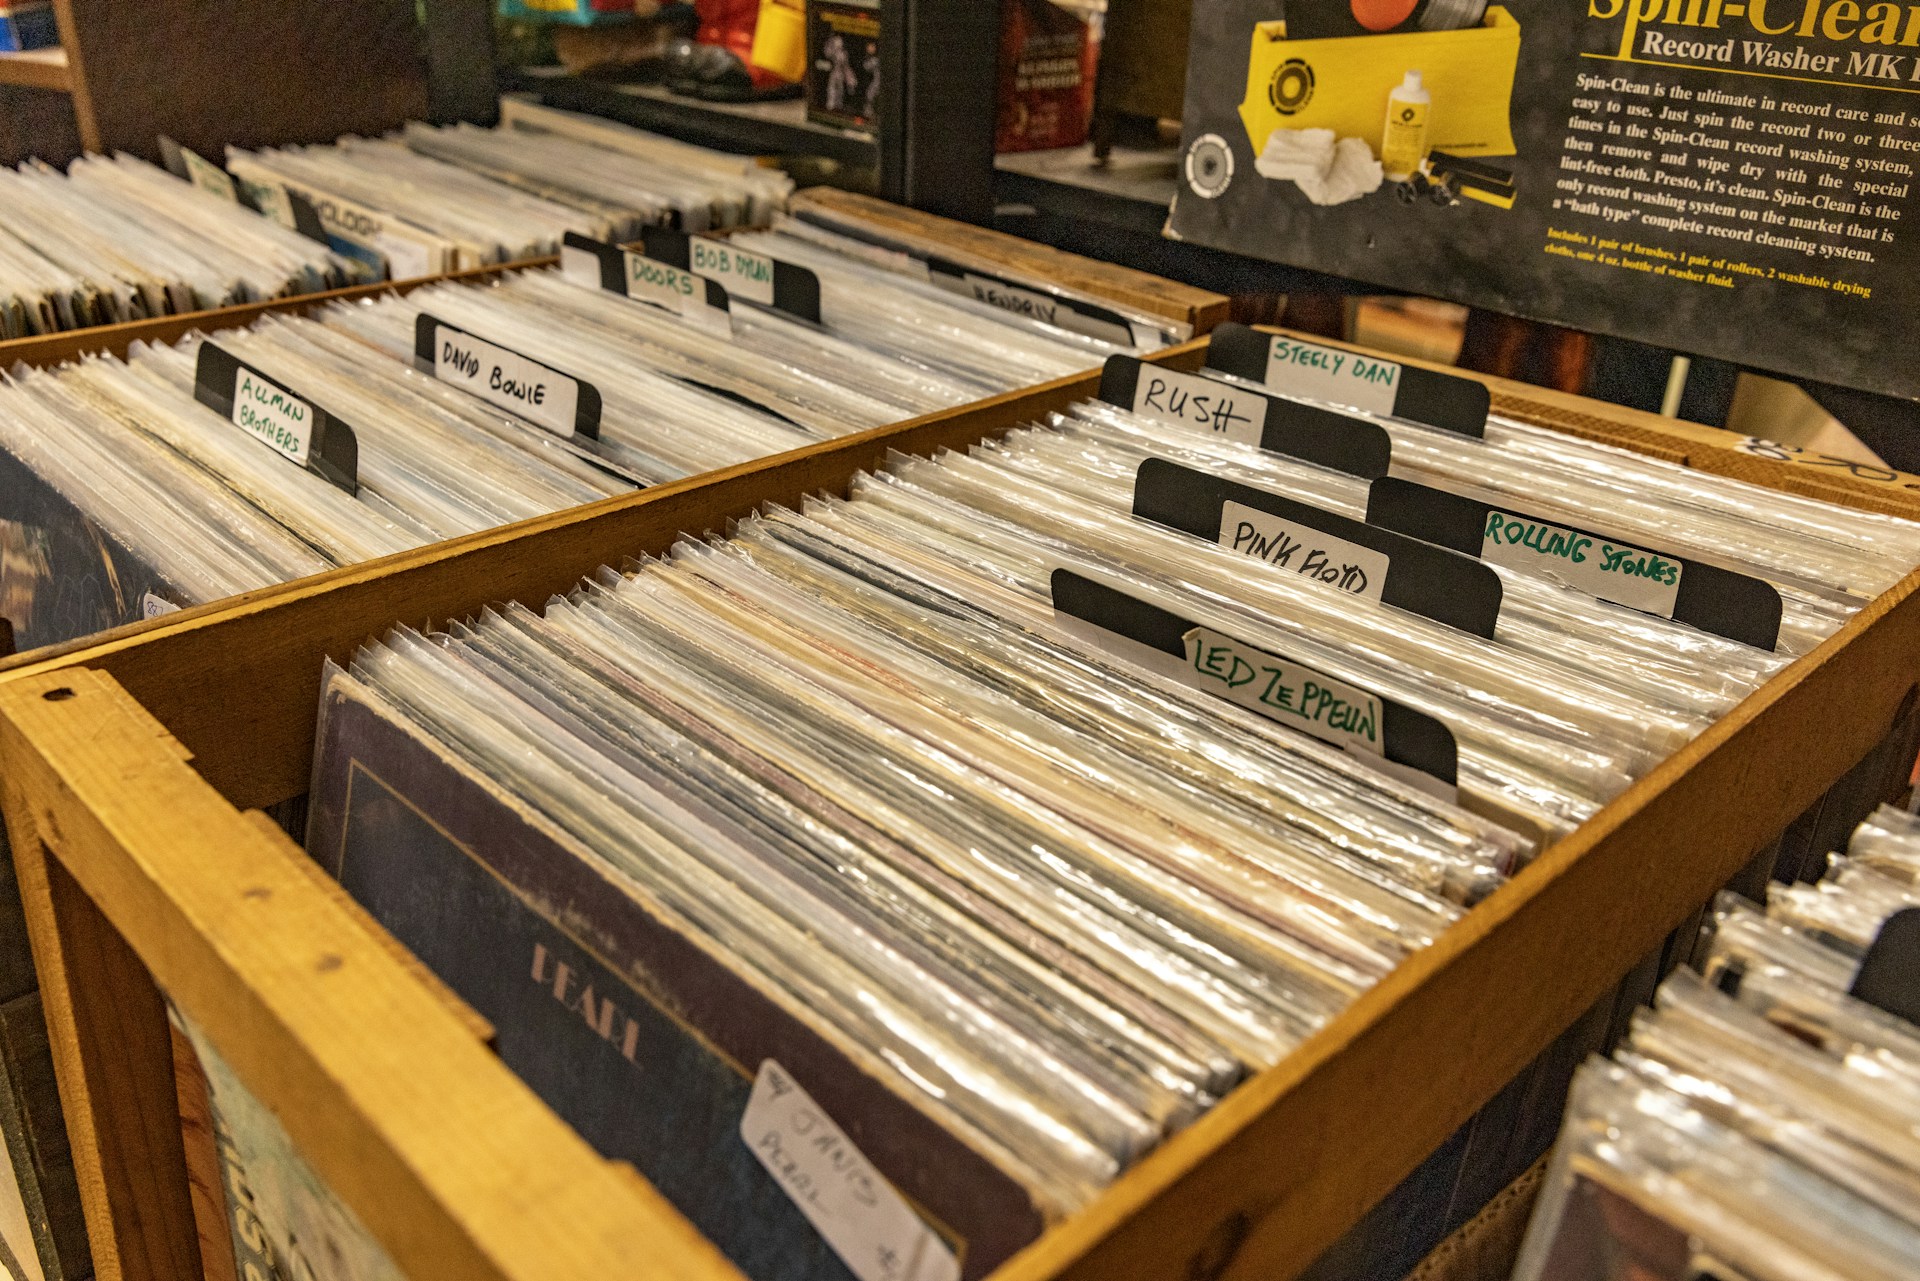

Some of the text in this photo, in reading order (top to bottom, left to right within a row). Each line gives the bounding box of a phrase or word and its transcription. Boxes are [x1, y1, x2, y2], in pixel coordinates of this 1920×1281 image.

[1641, 30, 1735, 62] Record
[1742, 40, 1839, 73] Washer
[1844, 51, 1906, 81] MK
[1572, 97, 1920, 152] easy to use. Just spin the record two or three
[1576, 73, 1650, 95] Spin-Clean
[1654, 82, 1666, 97] is
[1670, 85, 1693, 100] the
[1696, 89, 1757, 108] ultimate
[1760, 96, 1776, 110] in
[1781, 101, 1831, 117] record
[1835, 107, 1869, 122] care
[1874, 111, 1906, 128] and
[1564, 136, 1909, 198] then remove and wipe dry with the special
[1568, 116, 1914, 178] times in the Spin-Clean record washing system,
[1556, 178, 1895, 243] only record washing system on the market that is
[1560, 155, 1901, 221] lint-free cloth. Presto, it’s clean. Spin-Clean is the
[694, 244, 730, 272] BOB
[1552, 198, 1562, 209] a
[1641, 213, 1704, 233] complete
[1706, 225, 1753, 242] record
[1756, 231, 1817, 257] cleaning
[1818, 243, 1875, 263] system.
[632, 256, 693, 295] DOORS
[1544, 243, 1735, 288] cloths, one 4 oz. bottle of washer fluid.
[1547, 226, 1588, 244] Includes
[1598, 238, 1619, 250] pair
[1621, 241, 1634, 253] of
[1634, 244, 1677, 261] brushes,
[1680, 251, 1686, 262] 1
[1687, 254, 1711, 267] pair
[1712, 259, 1726, 270] of
[1727, 261, 1765, 278] rollers,
[1767, 267, 1776, 279] 2
[1778, 270, 1831, 289] washable
[1832, 280, 1872, 299] drying
[443, 341, 546, 405] DAVID BOWIE
[1273, 341, 1397, 386] STEELY DAN
[241, 377, 304, 421] ALLMAN
[1144, 378, 1251, 433] RUSH
[240, 404, 300, 453] BROTHERS
[1233, 521, 1302, 568] PINK
[1484, 512, 1678, 586] ROLLING STONES
[1194, 639, 1376, 742] LED ZEPPELIN
